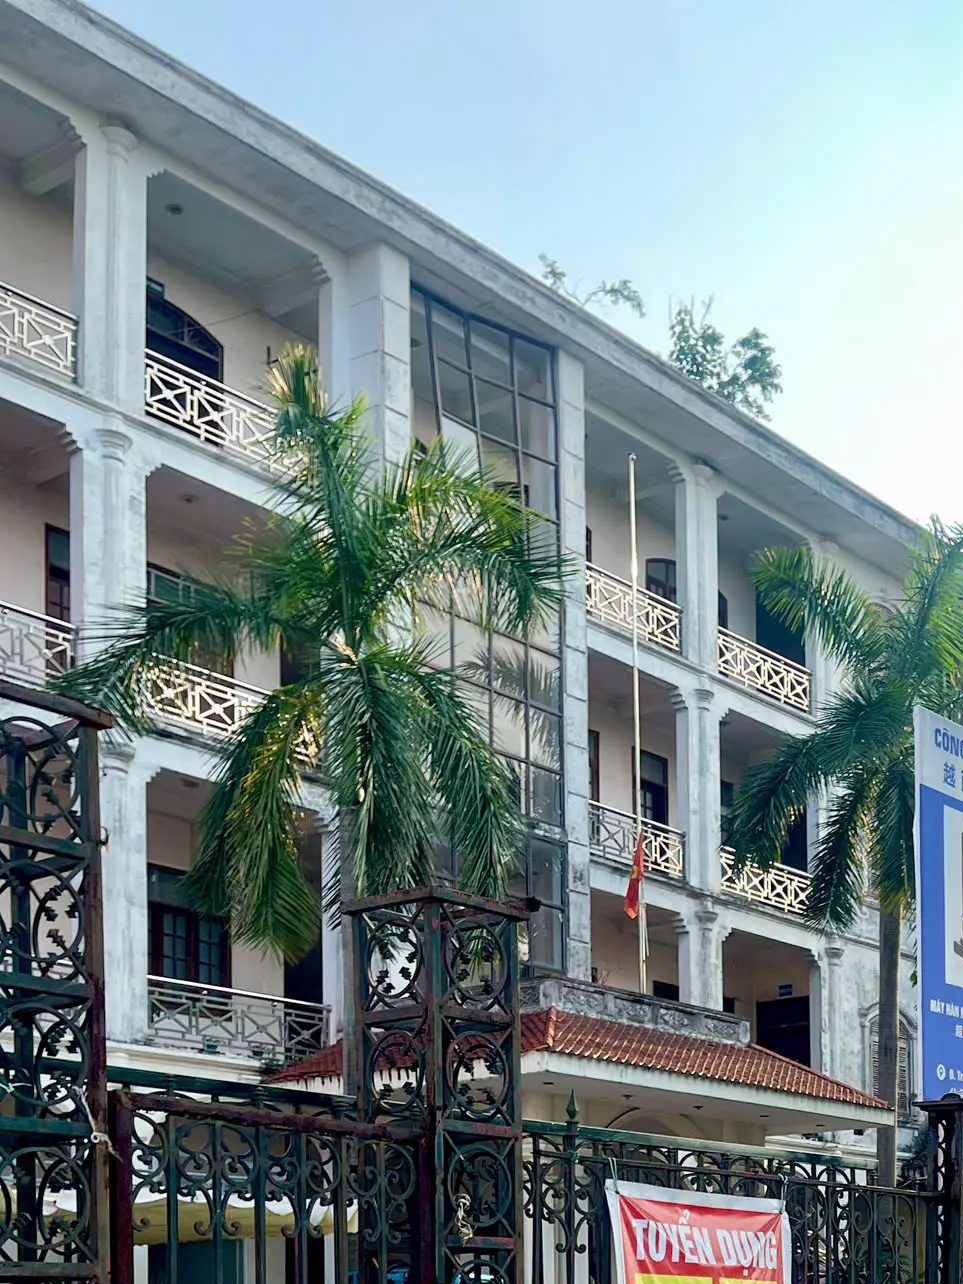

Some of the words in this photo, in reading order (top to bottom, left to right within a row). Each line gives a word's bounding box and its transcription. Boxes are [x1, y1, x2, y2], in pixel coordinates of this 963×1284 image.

[930, 999, 945, 1015] MÁY
[632, 1209, 715, 1265] TUYỂN
[716, 1228, 777, 1276] DỤNG
